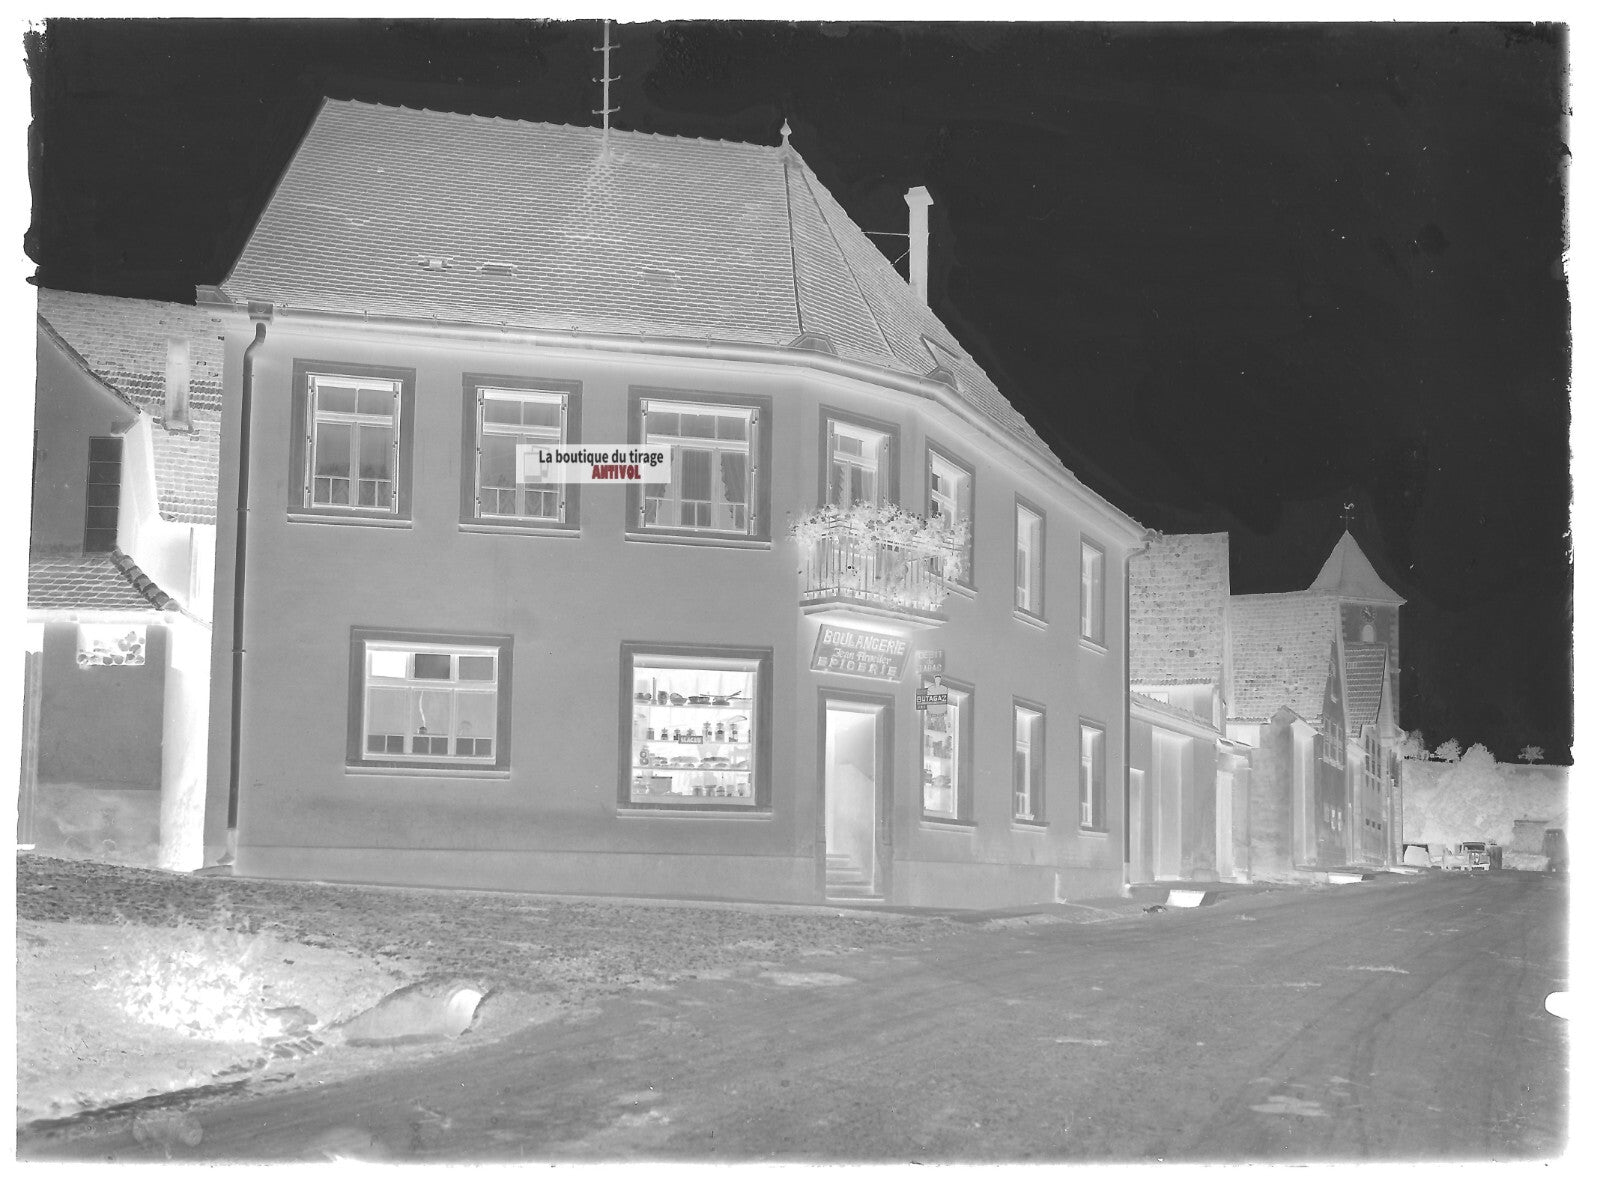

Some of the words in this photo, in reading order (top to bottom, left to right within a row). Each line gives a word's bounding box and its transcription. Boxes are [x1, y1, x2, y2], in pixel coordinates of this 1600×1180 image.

[823, 628, 906, 655] BOULANGERIE
[817, 656, 898, 676] EPICERIE
[917, 695, 947, 703] BUTAGAZ
